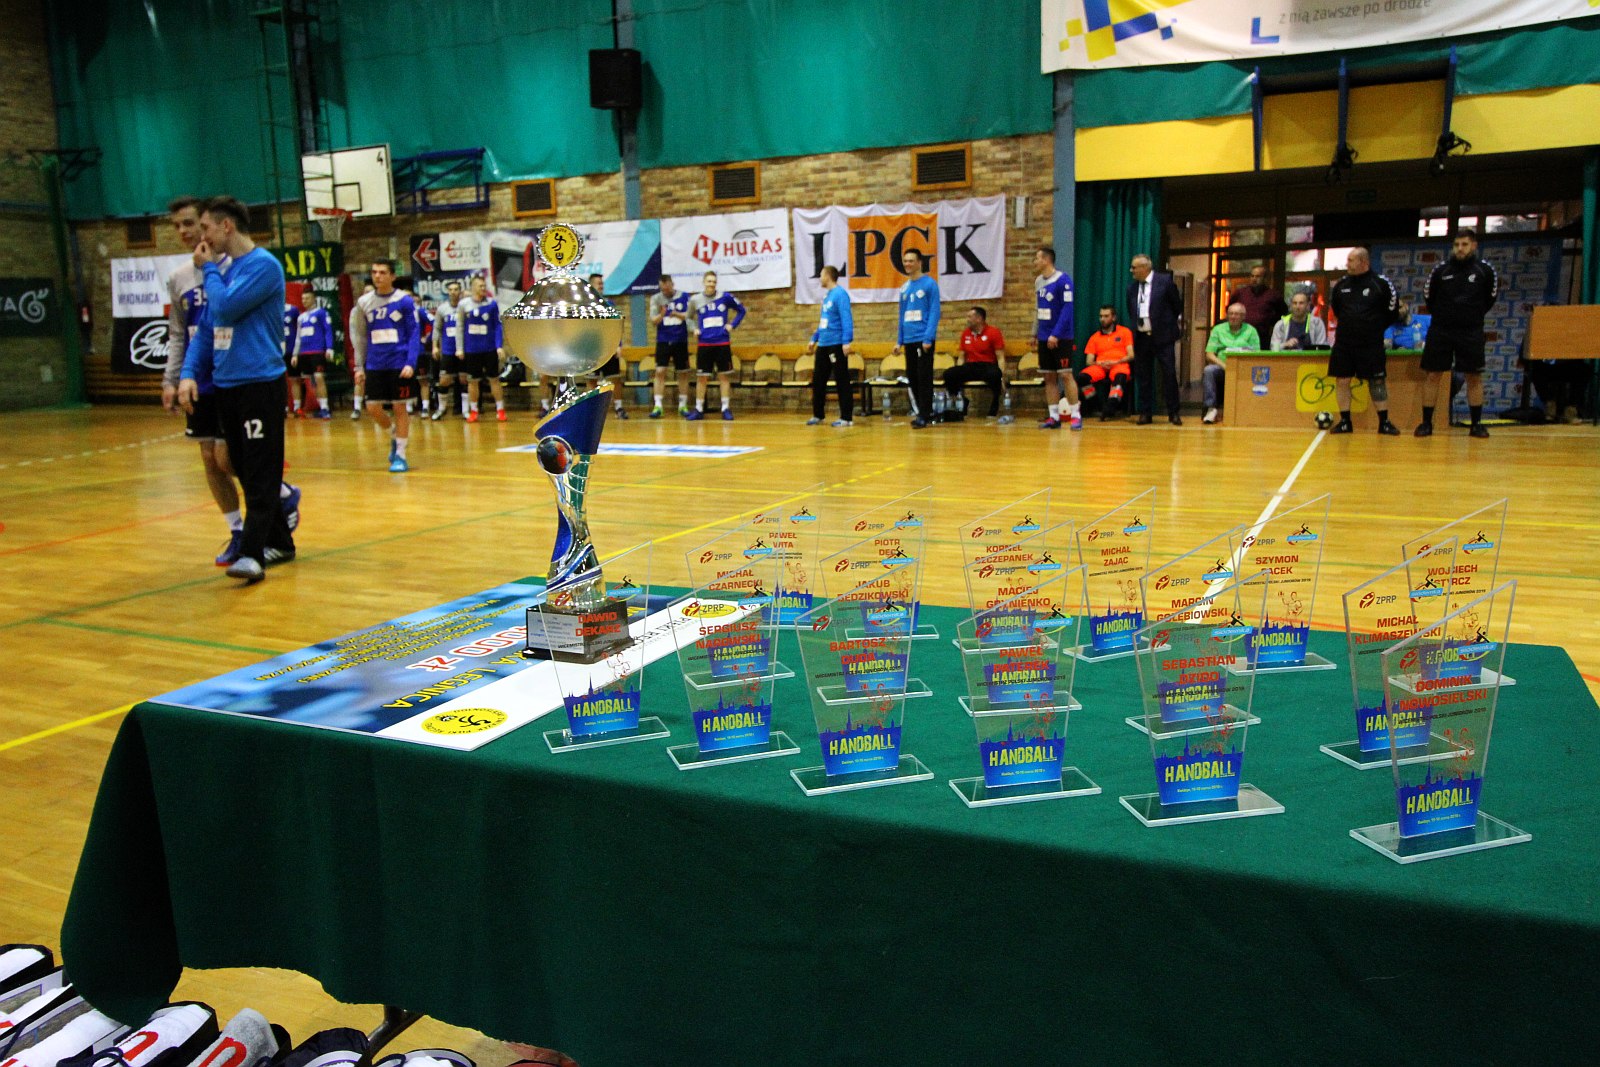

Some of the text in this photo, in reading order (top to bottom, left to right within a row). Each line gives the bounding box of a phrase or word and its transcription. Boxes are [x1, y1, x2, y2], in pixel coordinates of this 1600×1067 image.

[1278, 14, 1286, 24] z
[1289, 11, 1310, 24] nią
[1313, 6, 1358, 21] zawsze
[1363, 1, 1380, 18] po
[723, 238, 783, 257] HURAS
[808, 222, 991, 280] LPGK
[243, 418, 264, 439] 12
[874, 538, 901, 546] PIOTR
[1099, 531, 1115, 539] ZPRP
[1256, 538, 1276, 546] ZPRP
[714, 552, 733, 561] ZPRP
[1101, 545, 1132, 556] MICHAŁ
[1433, 547, 1453, 555] ZPRP
[1103, 556, 1129, 567] ZAJĄC
[1255, 555, 1299, 565] SZYMON
[708, 579, 763, 592] CZARNECKI
[1170, 578, 1190, 587] ZPRP
[1375, 595, 1397, 605] ZPRP
[702, 603, 725, 613] ZPRP
[577, 611, 618, 624] DAWID
[1376, 614, 1419, 629] MICHAŁ
[575, 623, 622, 637] DEKARZ
[698, 621, 758, 636] SERGIUSZ
[1096, 618, 1138, 635] HANDBALL
[829, 637, 887, 652] BARTOSZ
[999, 645, 1044, 659] PAWEŁ
[840, 652, 876, 665] DUDA
[1162, 654, 1236, 671] SEBASTIAN
[993, 660, 1050, 673] PATEREK
[1179, 670, 1220, 685] DZIDO
[1415, 674, 1473, 693] DOMINIK
[383, 667, 499, 709] LEGNICA
[572, 697, 635, 718] HANDBALL
[1399, 688, 1488, 712] NOWOSIELSKI
[702, 711, 766, 733] HANDBALL
[829, 733, 895, 756] HANDBALL
[989, 746, 1057, 767] HANDBALL
[1165, 760, 1236, 783] HANDBALL
[1406, 786, 1474, 815] HANDBALL
